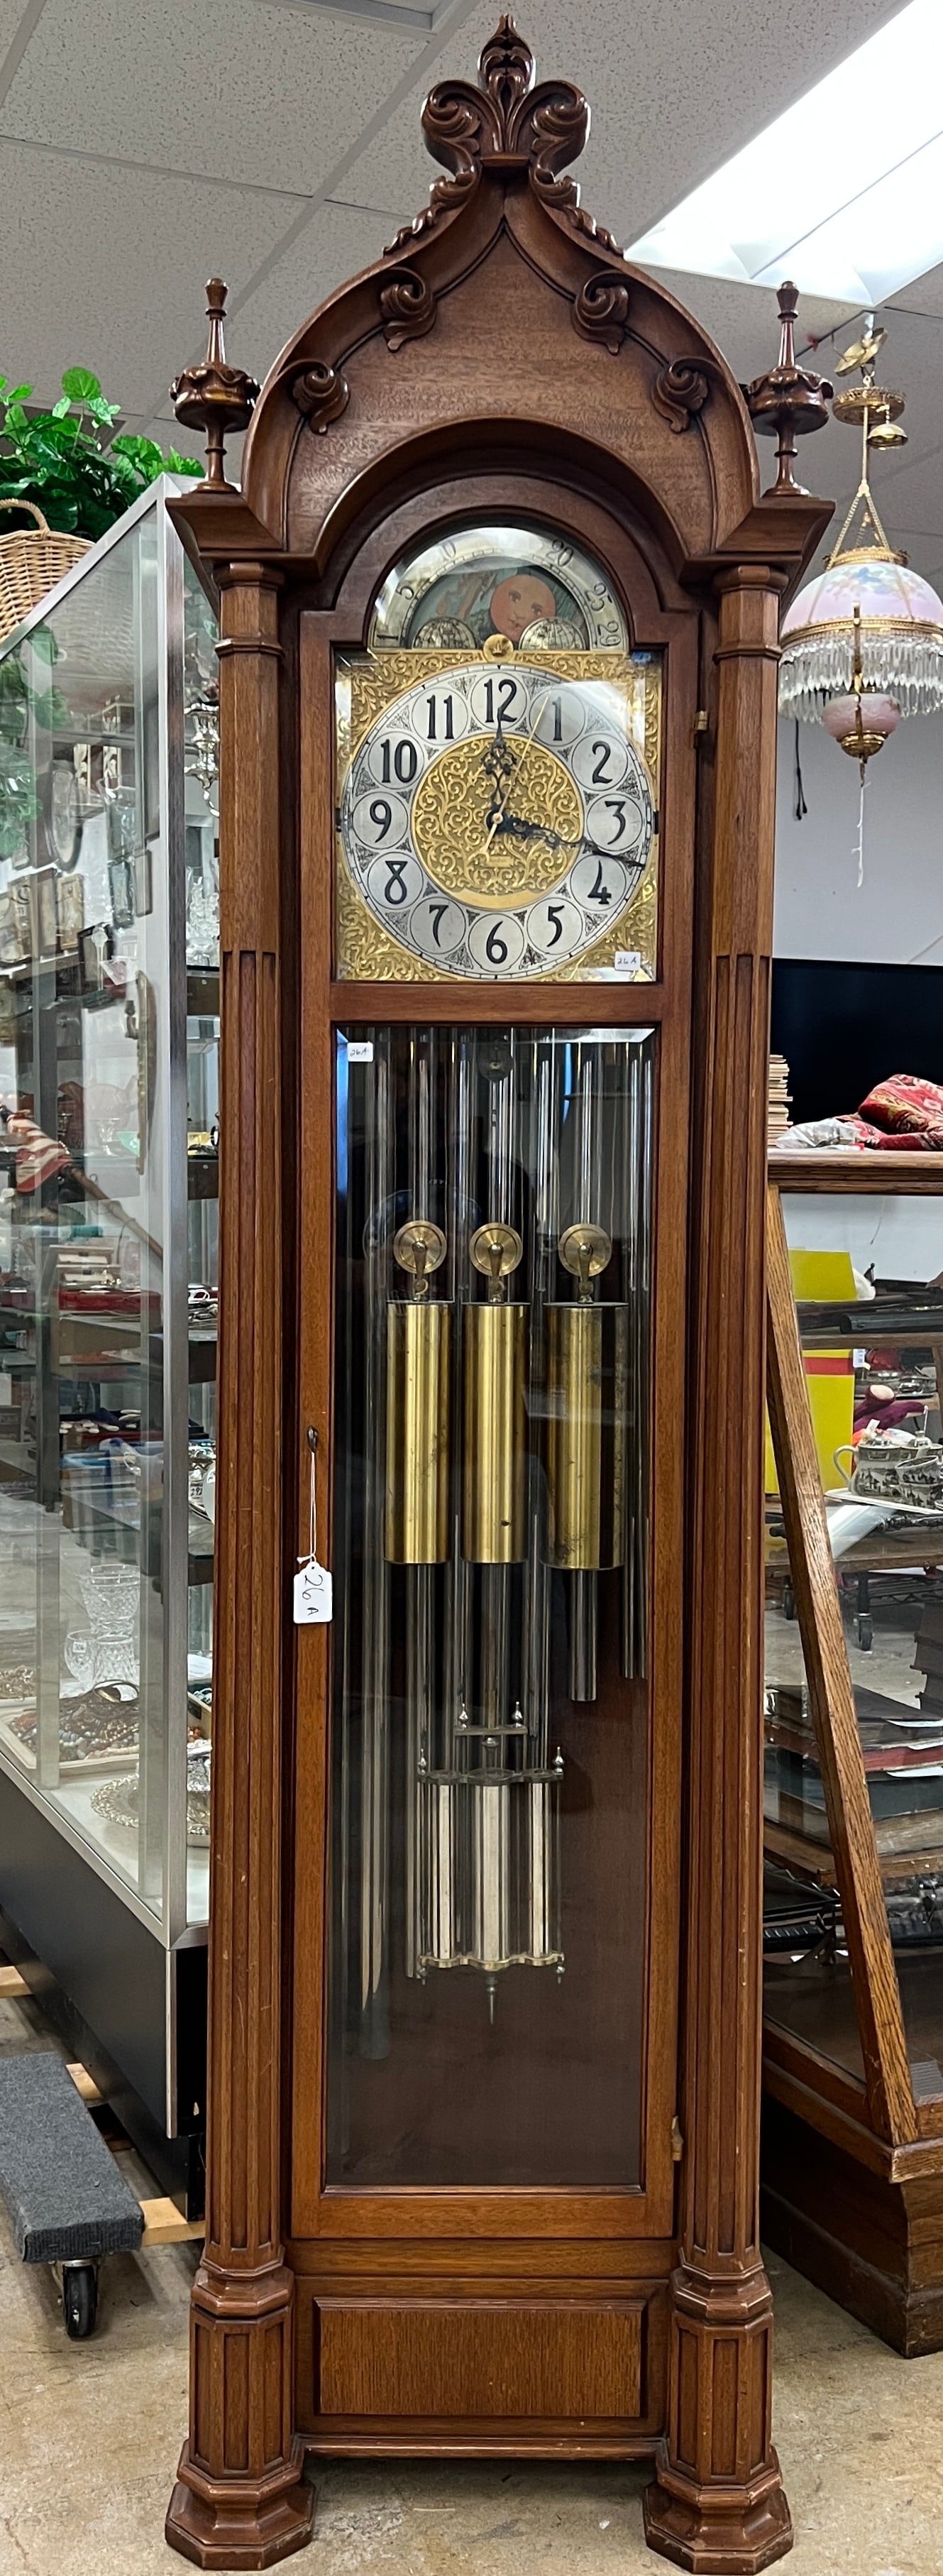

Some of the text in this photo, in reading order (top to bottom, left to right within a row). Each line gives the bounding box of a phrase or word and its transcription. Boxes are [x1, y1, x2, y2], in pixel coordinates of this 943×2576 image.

[546, 539, 574, 566] 20
[395, 585, 414, 601] 5
[584, 582, 612, 611] 25
[597, 620, 622, 647] 29
[426, 695, 454, 740] 11
[483, 679, 517, 723] 12
[551, 696, 563, 742] 1
[380, 738, 417, 784] 10
[591, 741, 613, 784] 2
[369, 799, 392, 843] 9
[603, 800, 627, 845] 3
[384, 860, 408, 905] 8
[587, 860, 612, 904] 4
[429, 904, 449, 948] 7
[485, 920, 509, 965] 6
[546, 905, 566, 948] 5
